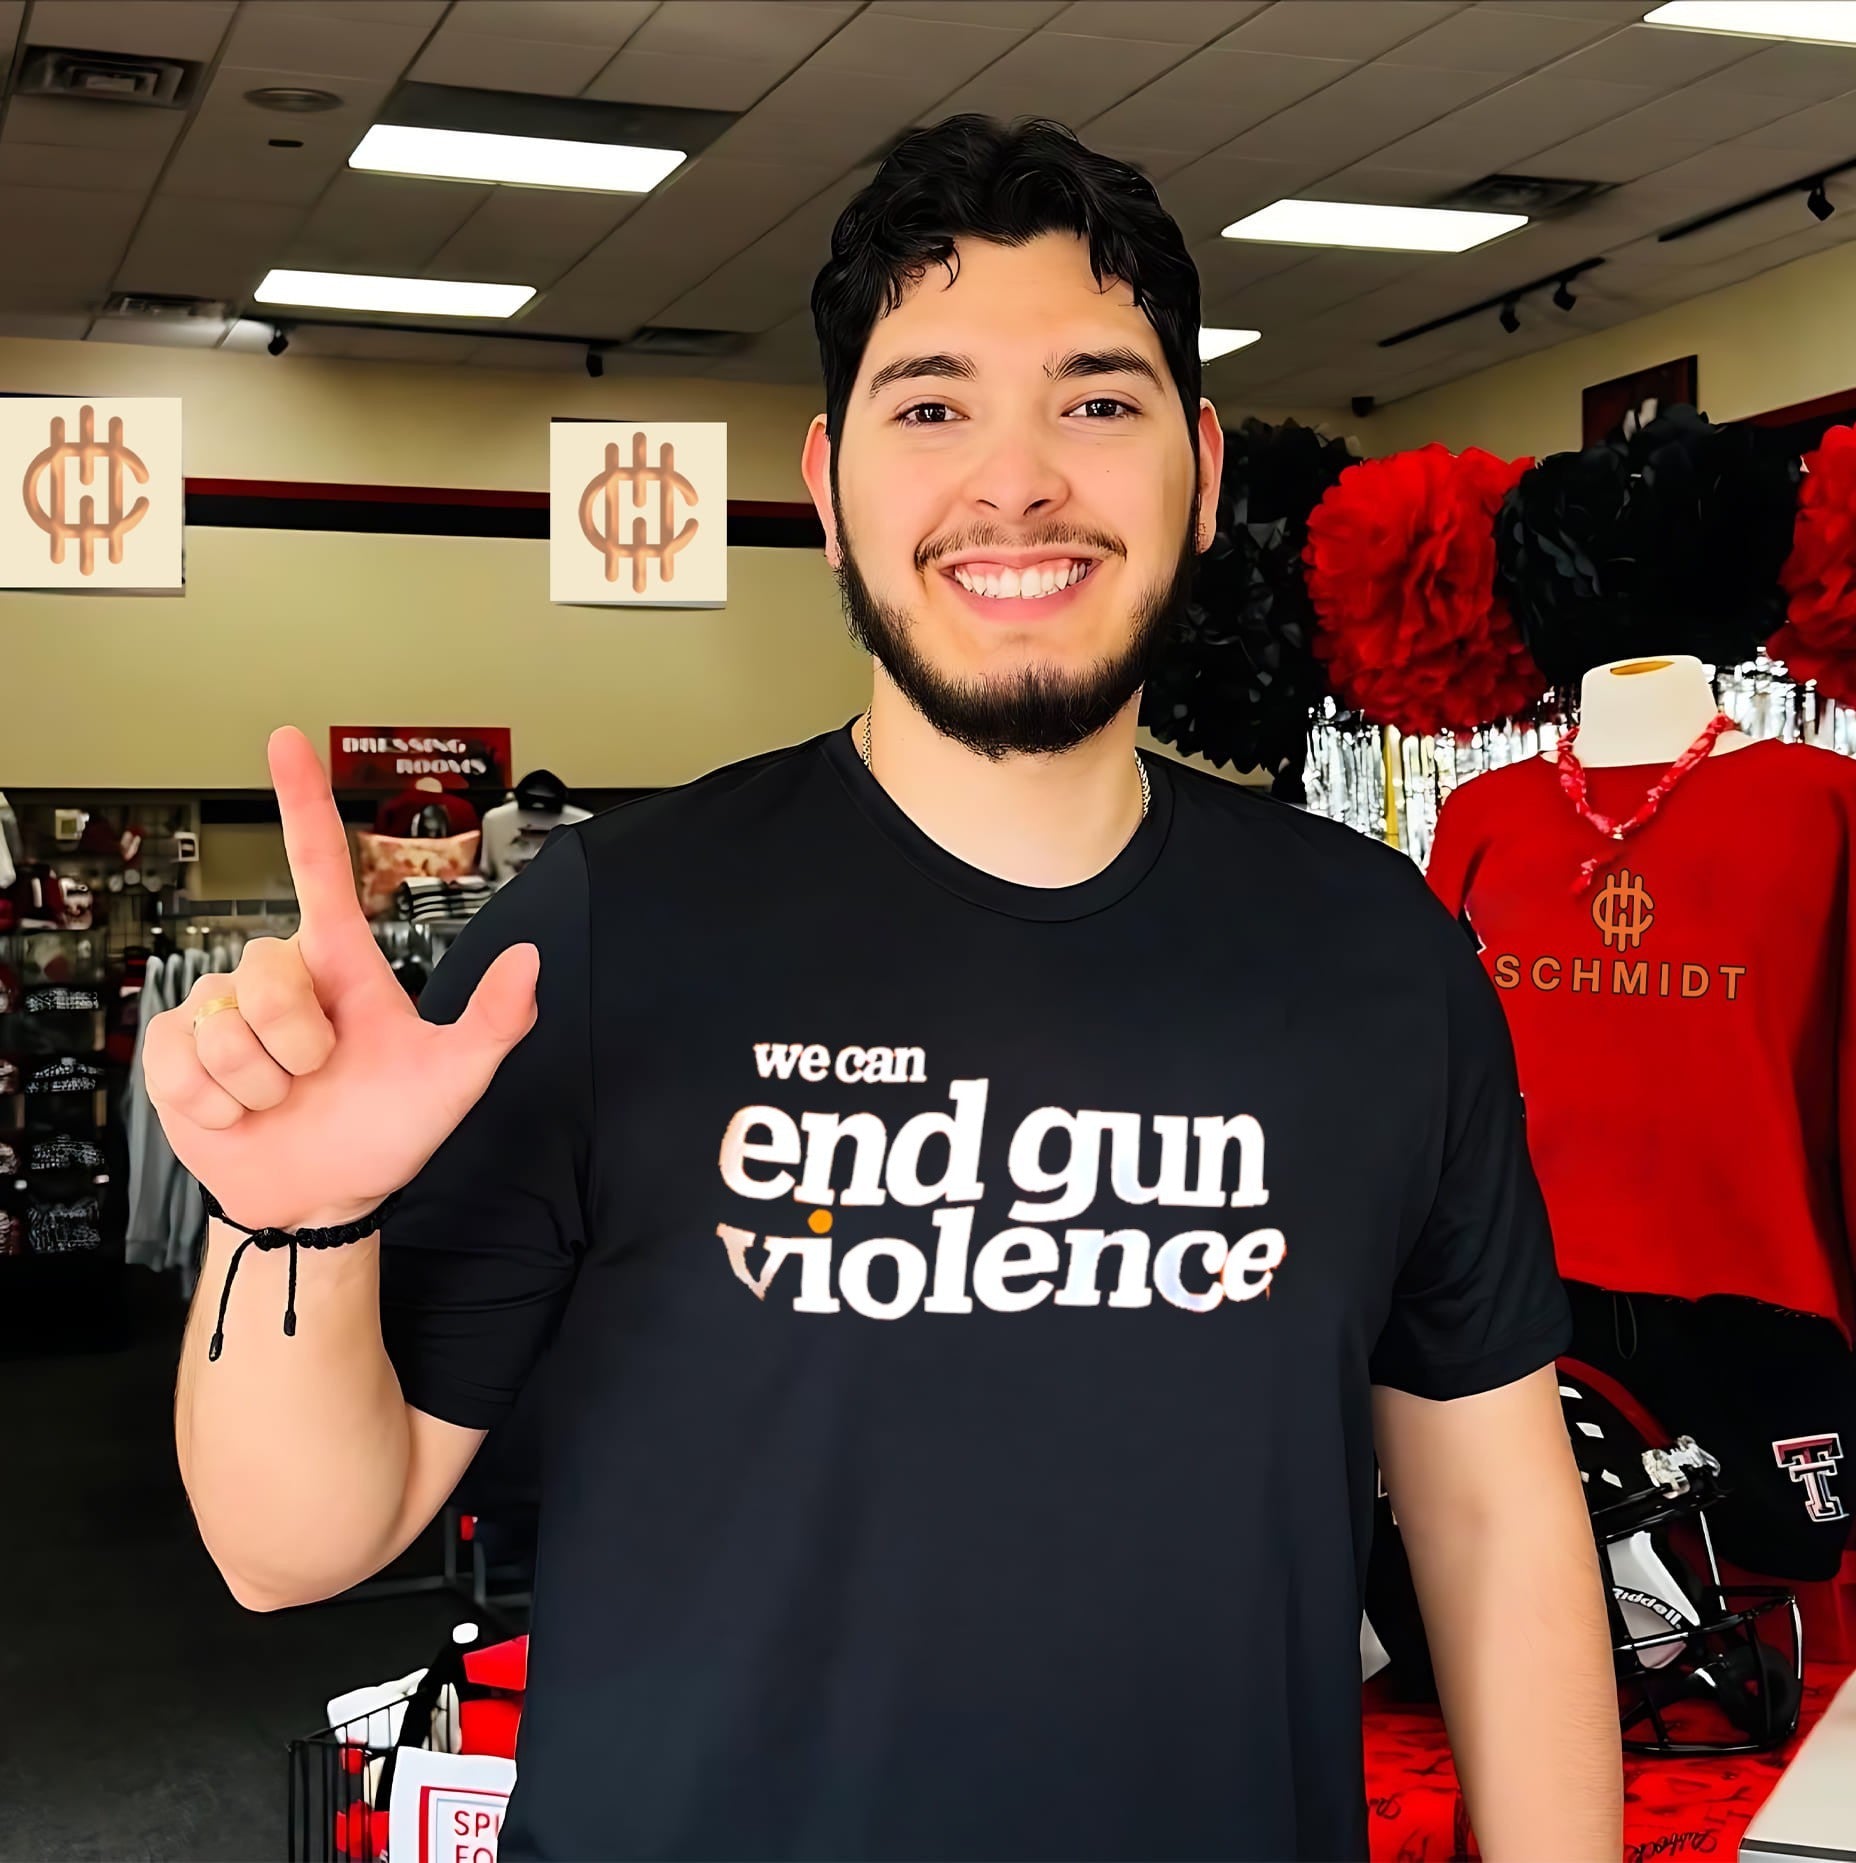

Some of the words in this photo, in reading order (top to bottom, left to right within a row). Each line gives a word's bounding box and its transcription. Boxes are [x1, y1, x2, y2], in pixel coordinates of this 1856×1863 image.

[342, 737, 466, 753] DRESSING
[396, 758, 487, 775] ROOMS
[1494, 953, 1746, 1000] SCHMIDT
[754, 1043, 830, 1082] we
[834, 1046, 927, 1083] can
[719, 1078, 989, 1207] end
[1008, 1106, 1269, 1222] gun
[716, 1206, 1287, 1321] violence
